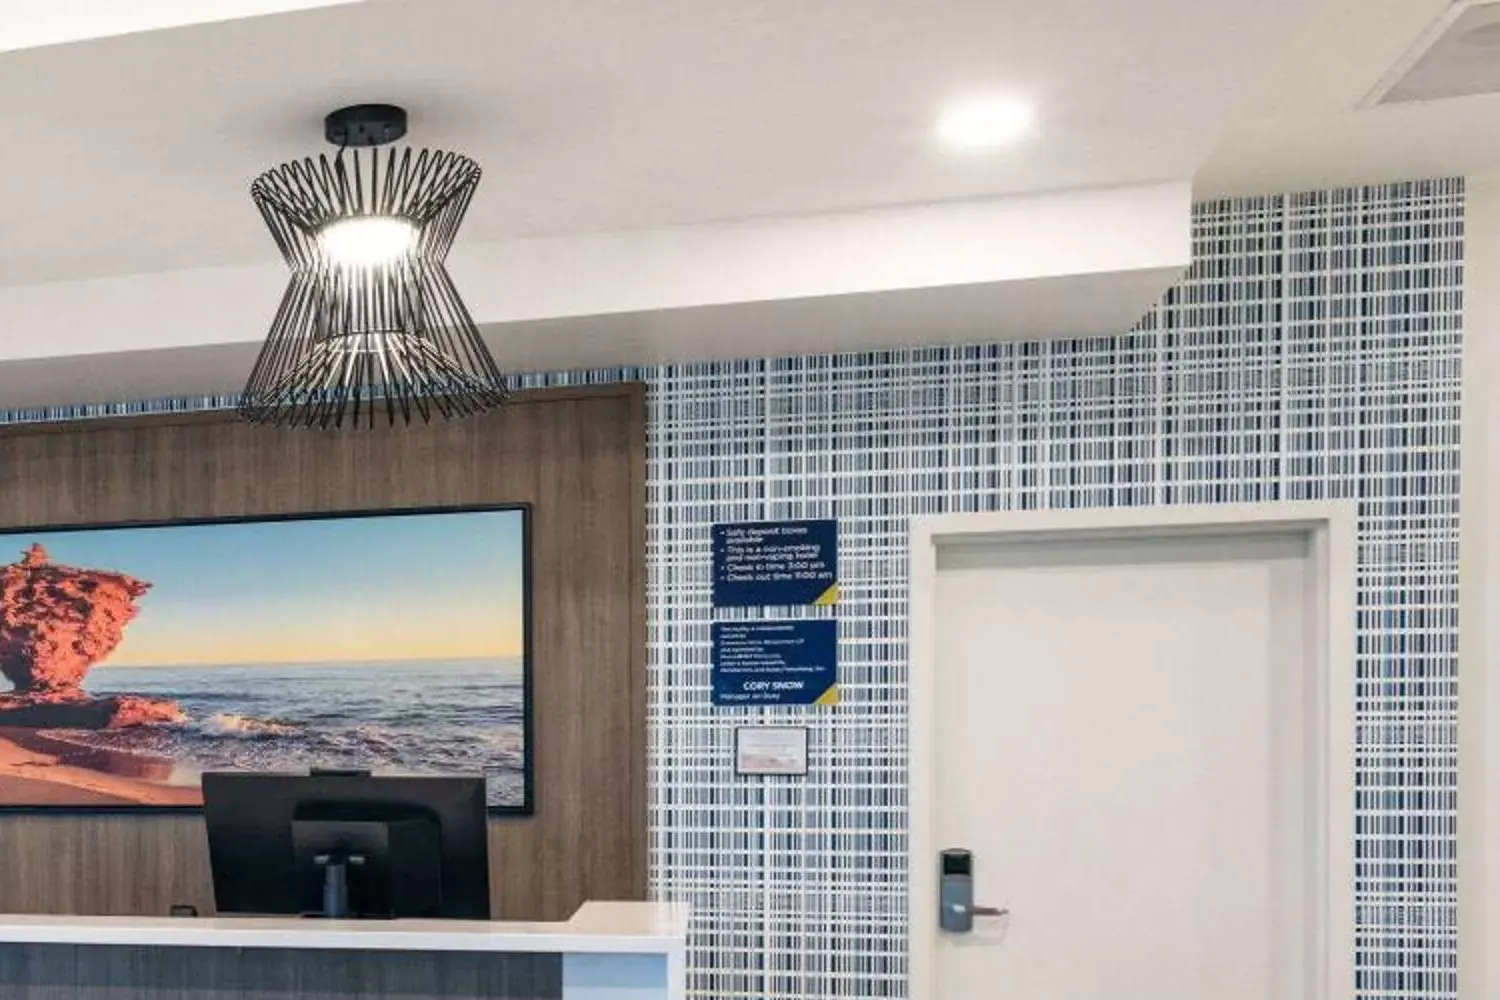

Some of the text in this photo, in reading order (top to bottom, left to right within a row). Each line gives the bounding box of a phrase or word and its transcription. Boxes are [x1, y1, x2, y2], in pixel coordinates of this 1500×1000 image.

[727, 563, 754, 573] Check
[727, 573, 754, 581] Check
[755, 572, 771, 581] out
[743, 680, 805, 691] CORY SNOW
